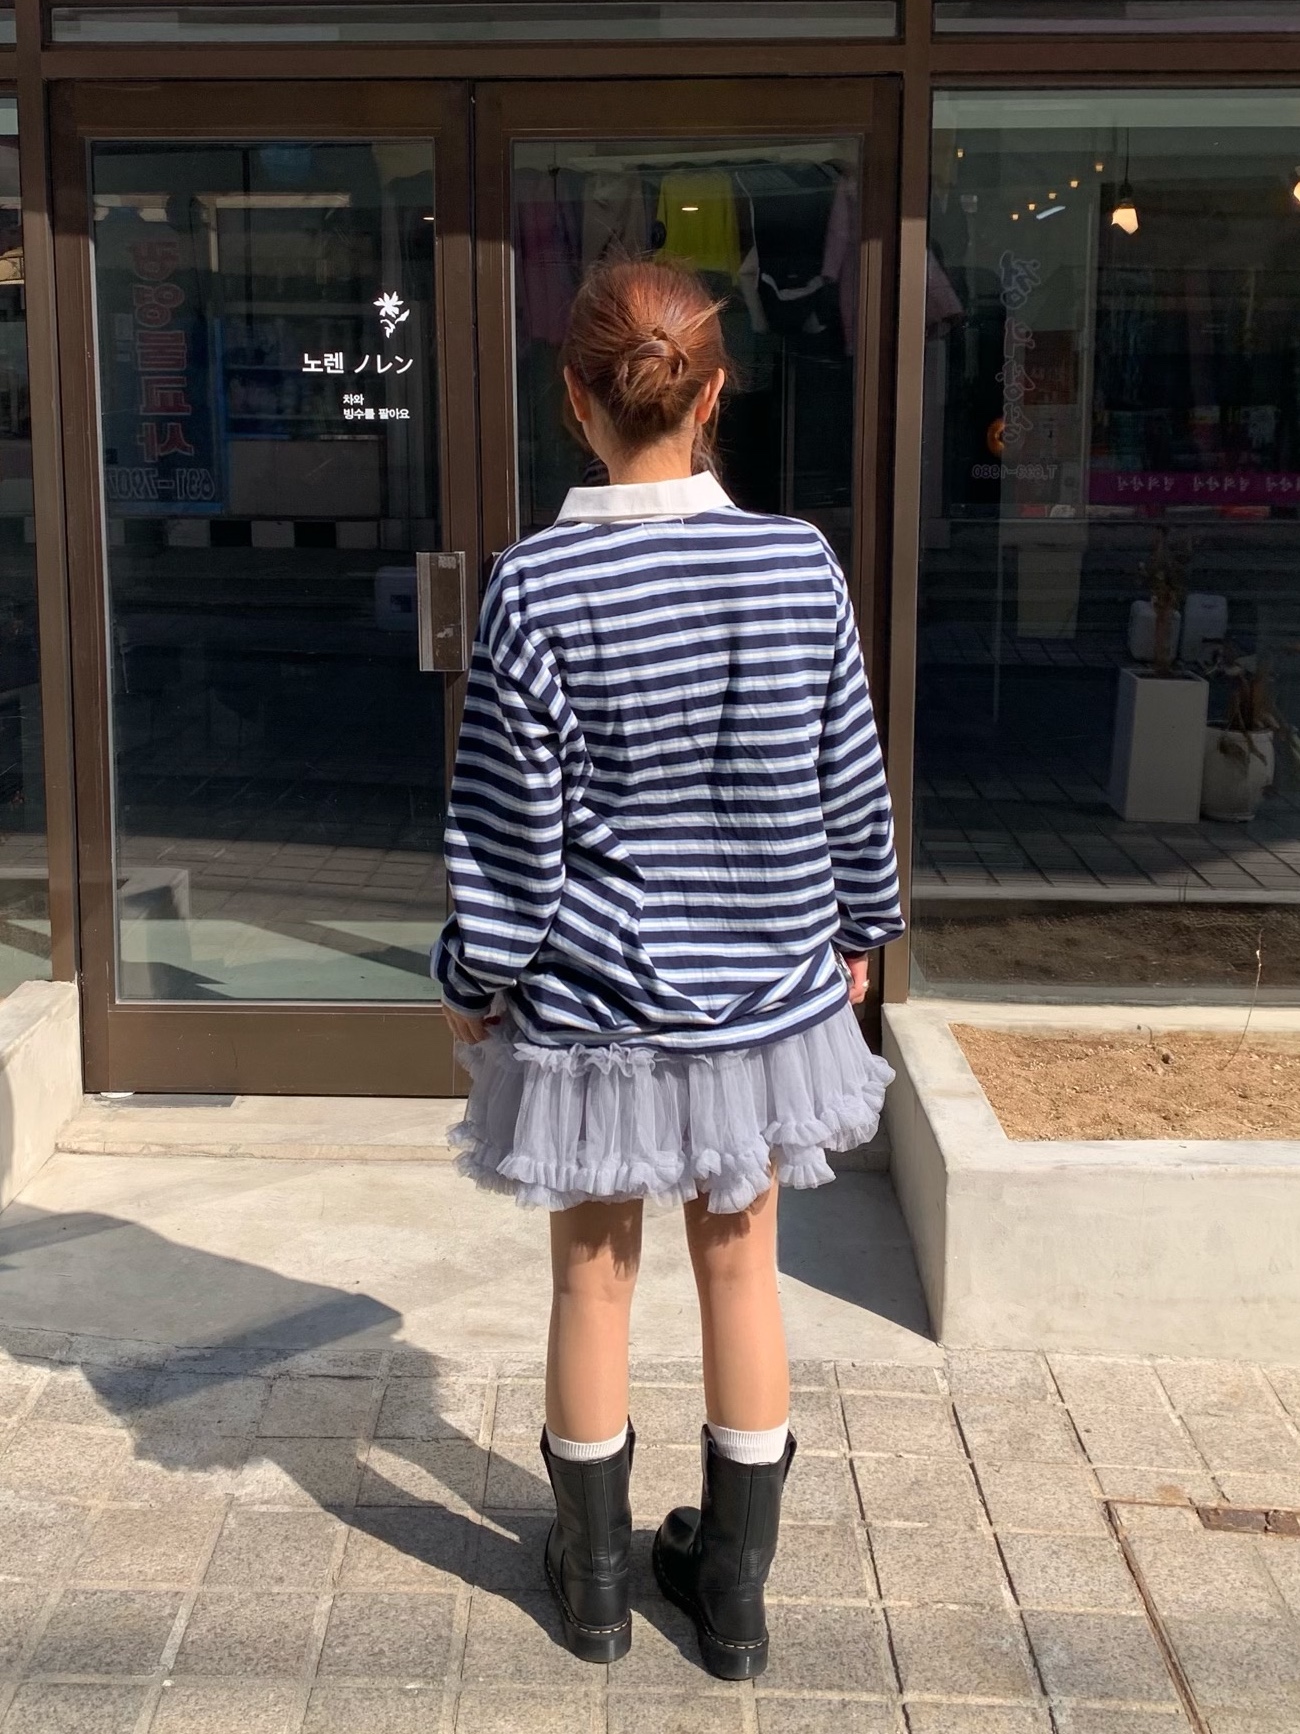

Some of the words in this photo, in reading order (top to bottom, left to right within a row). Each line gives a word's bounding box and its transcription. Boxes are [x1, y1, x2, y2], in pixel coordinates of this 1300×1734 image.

[302, 352, 344, 374] 노렌
[354, 354, 413, 374] ノレン
[343, 394, 364, 405] 차와
[343, 408, 375, 420] 빙수를
[378, 408, 410, 420] 팔아요
